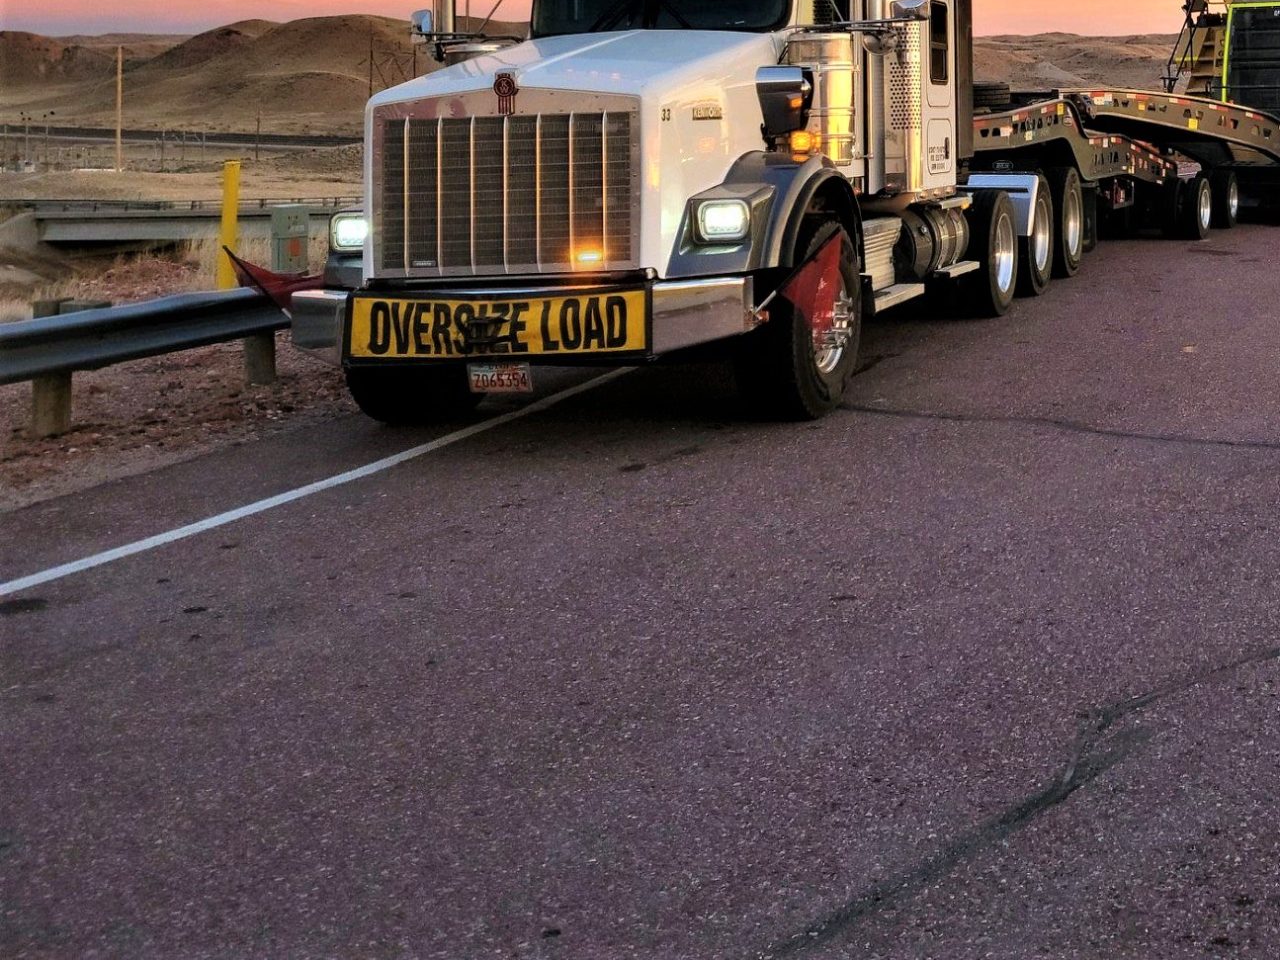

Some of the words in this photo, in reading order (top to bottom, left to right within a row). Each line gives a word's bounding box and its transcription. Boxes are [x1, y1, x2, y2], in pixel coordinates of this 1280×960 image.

[661, 108, 671, 121] 33
[369, 300, 529, 356] OVERSIZE
[540, 295, 627, 352] LOAD
